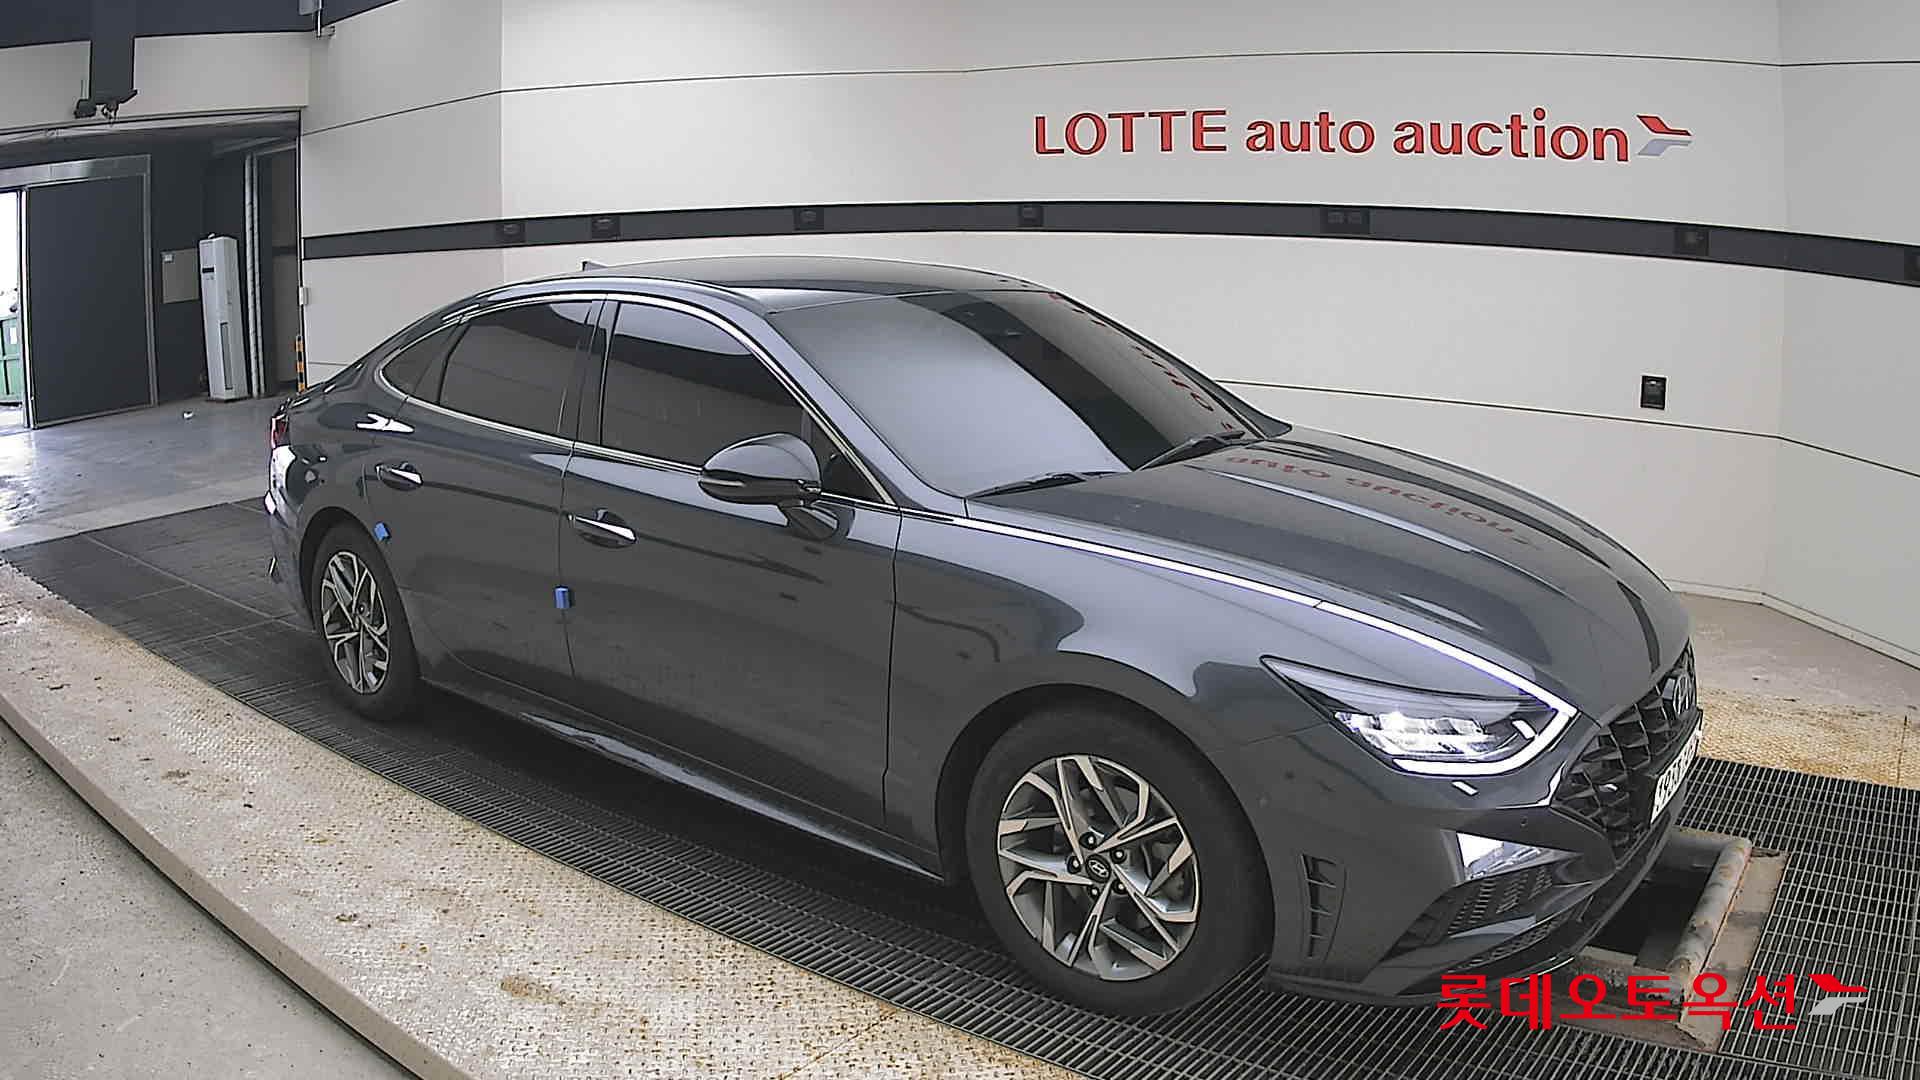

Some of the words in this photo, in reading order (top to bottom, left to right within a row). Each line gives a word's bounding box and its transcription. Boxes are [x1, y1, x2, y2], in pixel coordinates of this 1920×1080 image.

[1035, 109, 1227, 155] LOTTE
[1246, 111, 1375, 155] auto
[1393, 107, 1630, 163] auction
